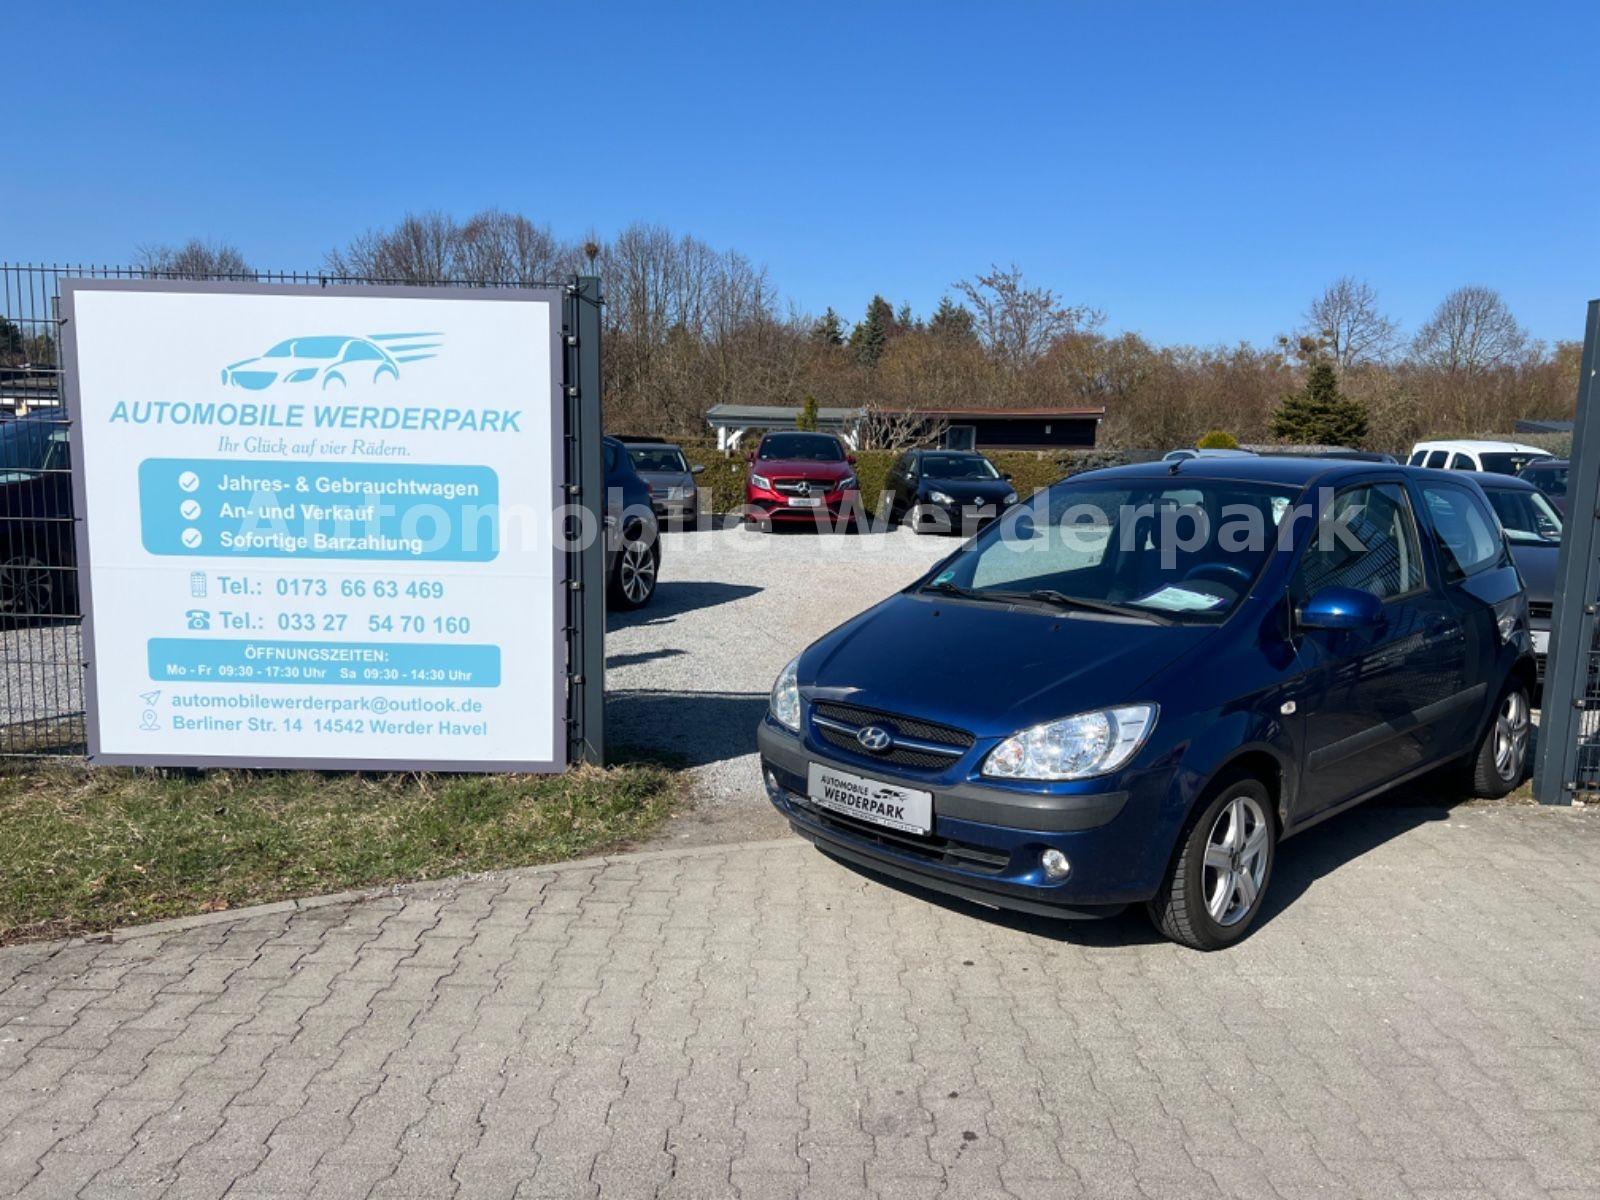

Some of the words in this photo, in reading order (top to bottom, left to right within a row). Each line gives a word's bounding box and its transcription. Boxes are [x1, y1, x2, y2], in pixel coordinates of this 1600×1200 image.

[109, 401, 304, 428] AUTOMOBILE
[313, 406, 523, 433] WERDERPARK
[217, 436, 238, 454] Ihr
[244, 437, 287, 457] Glück
[290, 438, 316, 458] auf
[320, 439, 346, 456] vier
[352, 439, 411, 457] Rädern.
[217, 475, 290, 493] Jahres-
[296, 475, 310, 493] &
[315, 477, 480, 498] Gebrauchtwagen
[219, 503, 253, 519] An-
[258, 504, 295, 521] und
[300, 504, 374, 522] Verkauf
[220, 532, 308, 552] Sofortige
[313, 532, 423, 555] Barzahlung
[217, 576, 263, 596] Tel.:
[276, 578, 327, 598] 0173
[341, 579, 366, 598] 66
[373, 579, 398, 599] 63
[406, 580, 444, 600] 469
[219, 611, 264, 631] Tel.:
[277, 613, 316, 632] 033
[323, 614, 347, 632] 27
[368, 615, 393, 633] 54
[400, 616, 426, 634] 70
[432, 616, 471, 635] 160
[245, 644, 389, 662] ÖFFNUNGSZEITEN:
[166, 664, 186, 676] Mo
[199, 665, 212, 677] Fr
[218, 665, 253, 678] 09:30
[265, 666, 300, 678] 17:30
[303, 666, 326, 679] Uhr
[340, 667, 357, 680] Sa
[364, 668, 398, 681] 09:30
[411, 668, 445, 682] 14:30
[449, 669, 472, 682] Uhr
[172, 693, 483, 714] automobilewerderpark@outlook.de
[173, 716, 242, 732] Berliner
[247, 716, 277, 733] Str.
[283, 718, 302, 733] 14
[315, 718, 364, 735] 14542
[369, 719, 433, 736] Werder
[439, 721, 487, 737] Havel
[820, 775, 870, 796] AUTOMOBILE
[824, 786, 904, 820] WERDERPARK
